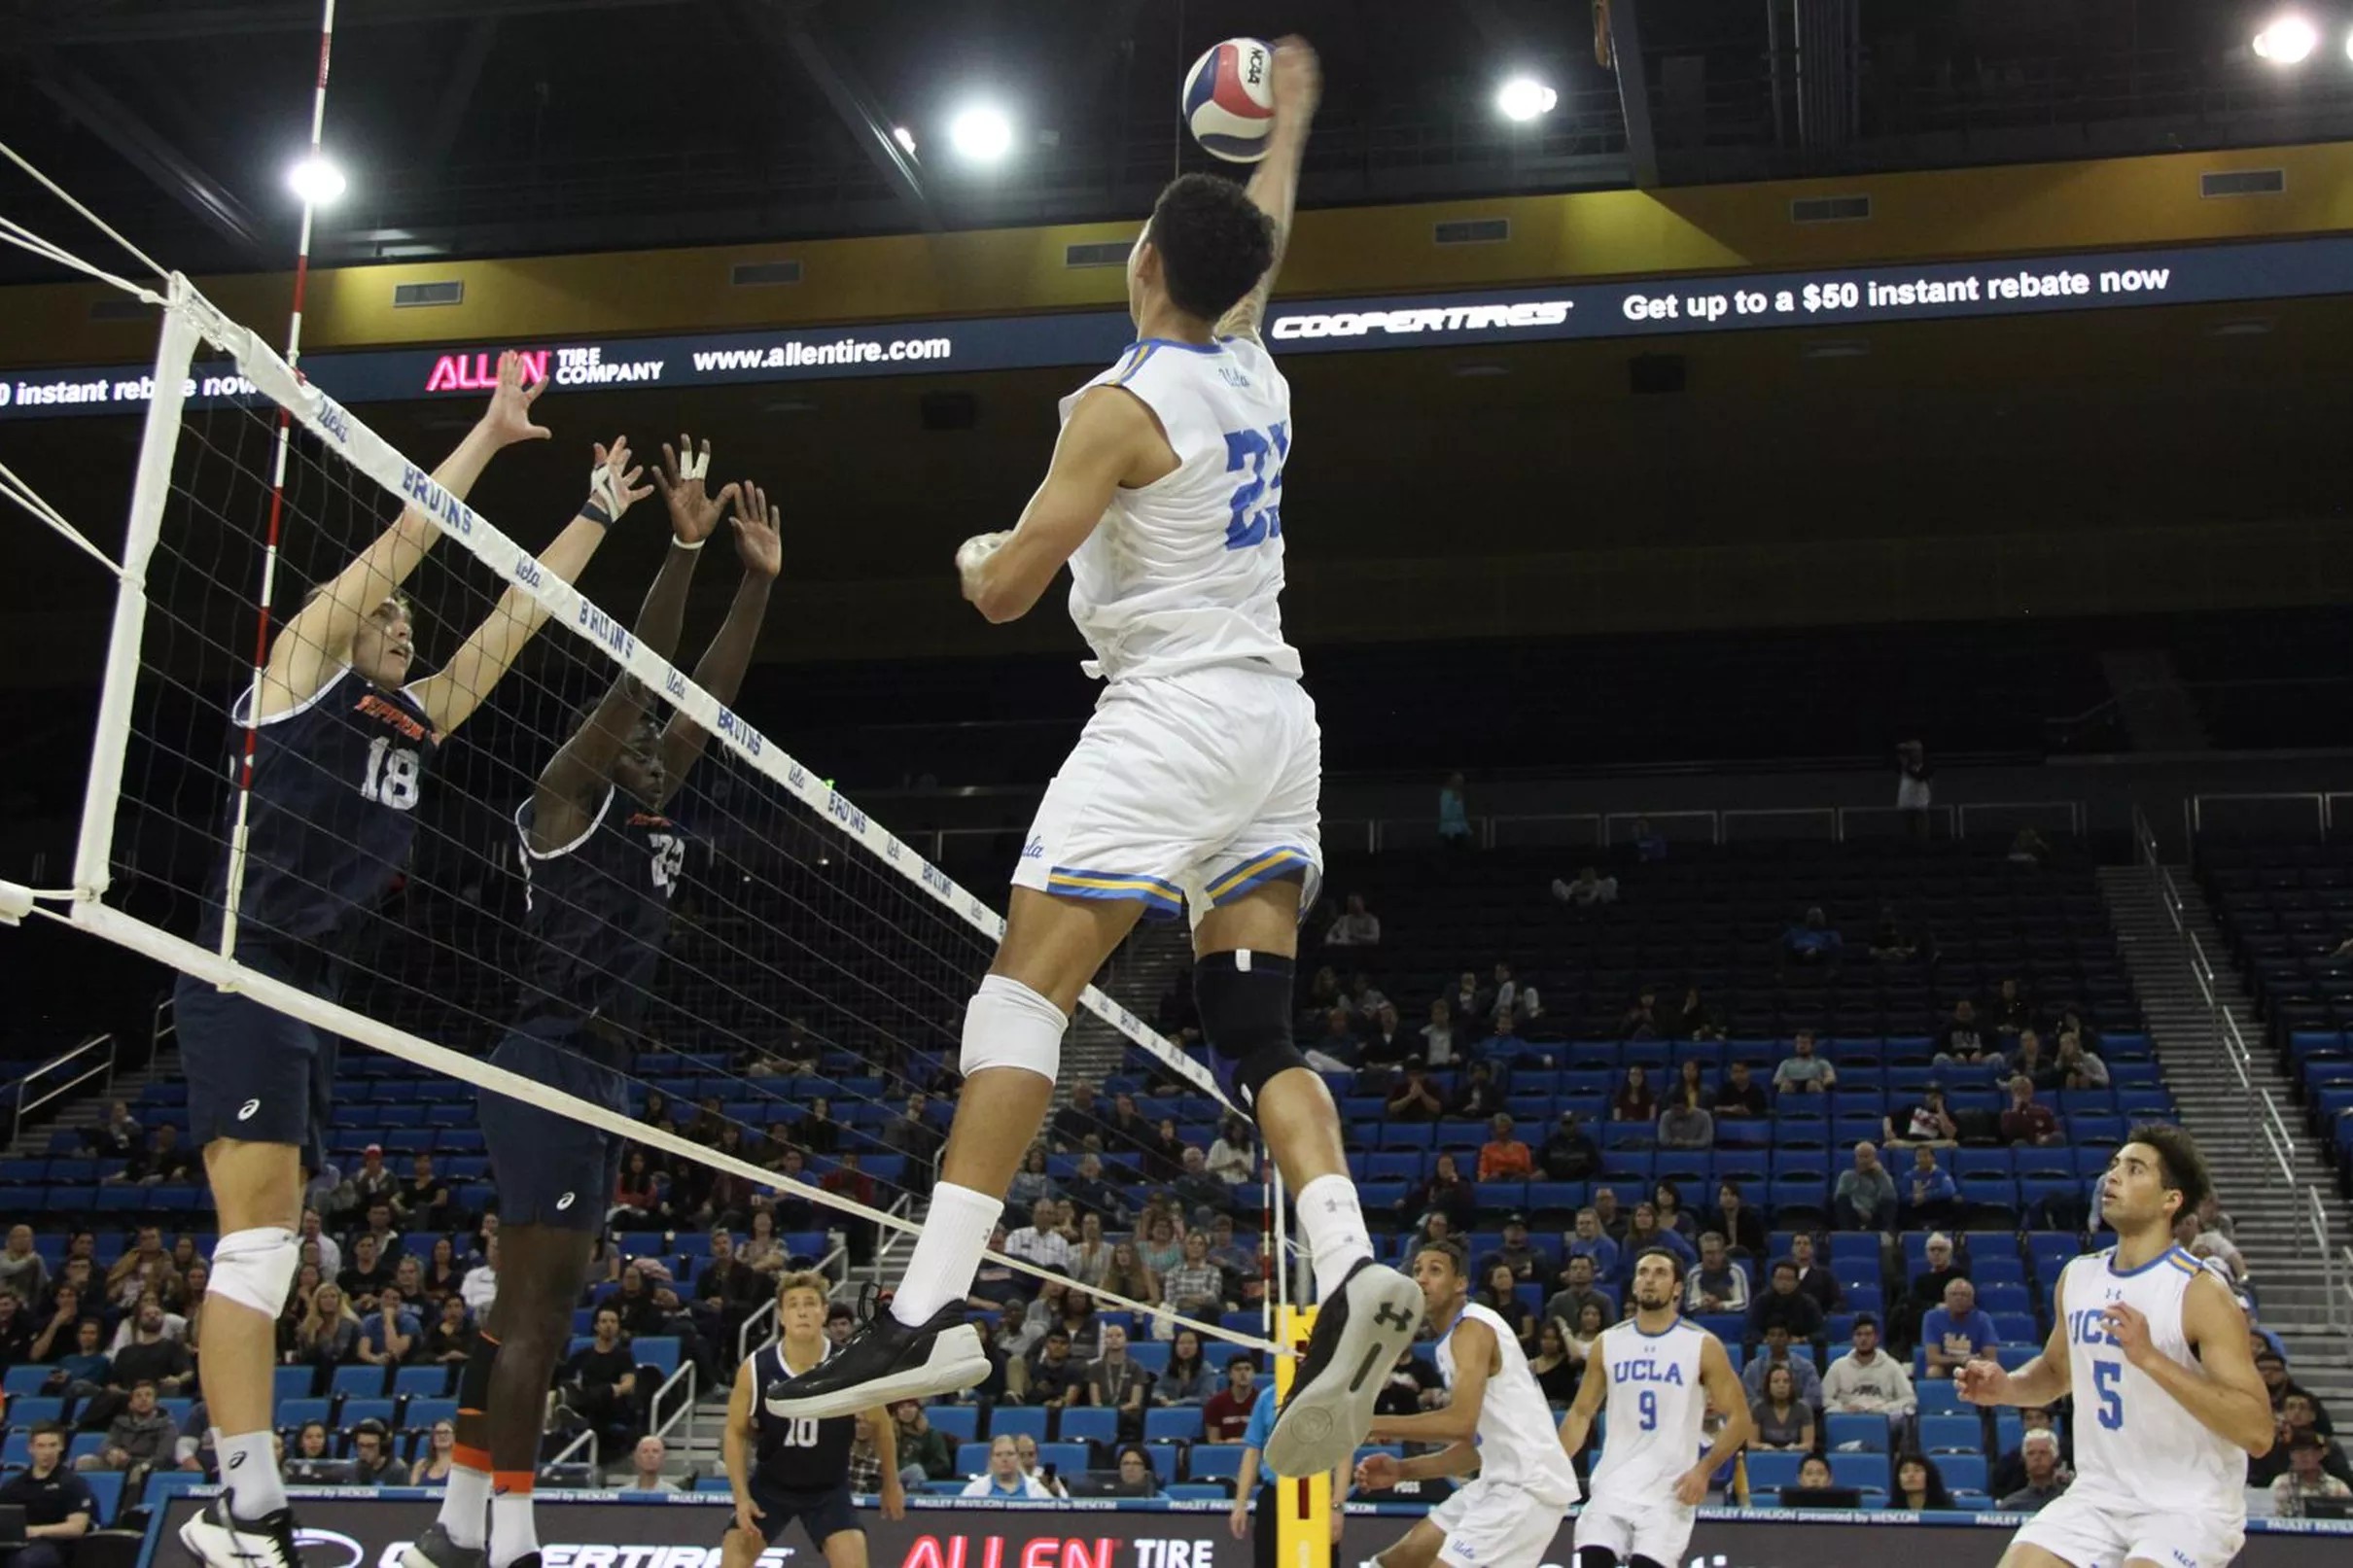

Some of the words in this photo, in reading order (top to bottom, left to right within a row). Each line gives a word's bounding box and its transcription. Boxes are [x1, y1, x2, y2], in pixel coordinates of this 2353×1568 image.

[1247, 48, 1265, 86] NCAA
[1623, 294, 1679, 321] Get
[1687, 296, 1728, 322] up
[1734, 289, 1768, 314] to
[1774, 292, 1795, 312] a
[1803, 281, 1859, 313] $50
[1868, 275, 1981, 306] instant
[1987, 270, 2090, 299] rebate
[2099, 266, 2170, 293] now
[556, 348, 601, 366] TIRE
[693, 337, 951, 371] www.allentire.com
[426, 351, 547, 392] ALLN
[555, 361, 664, 385] COMPANY
[17, 379, 108, 405] instant
[114, 375, 196, 401] rebe
[403, 465, 473, 535] BRUINS
[579, 599, 635, 659] BRUINS
[718, 706, 762, 756] BRUINS
[361, 736, 419, 810] 18
[1614, 1359, 1683, 1386] UCLA
[1639, 1390, 1658, 1431] 9
[2093, 1359, 2124, 1431] 5
[784, 1416, 820, 1447] 10
[953, 1498, 1004, 1509] PAVILION
[1699, 1508, 1738, 1519] PAULEY
[1741, 1509, 1796, 1520] PAVILION
[1798, 1511, 1851, 1521] presented
[1854, 1511, 1869, 1523] by
[1976, 1514, 2019, 1525] PAULEY
[2266, 1518, 2312, 1532] PAULEY
[1134, 1539, 1213, 1568] TIRE
